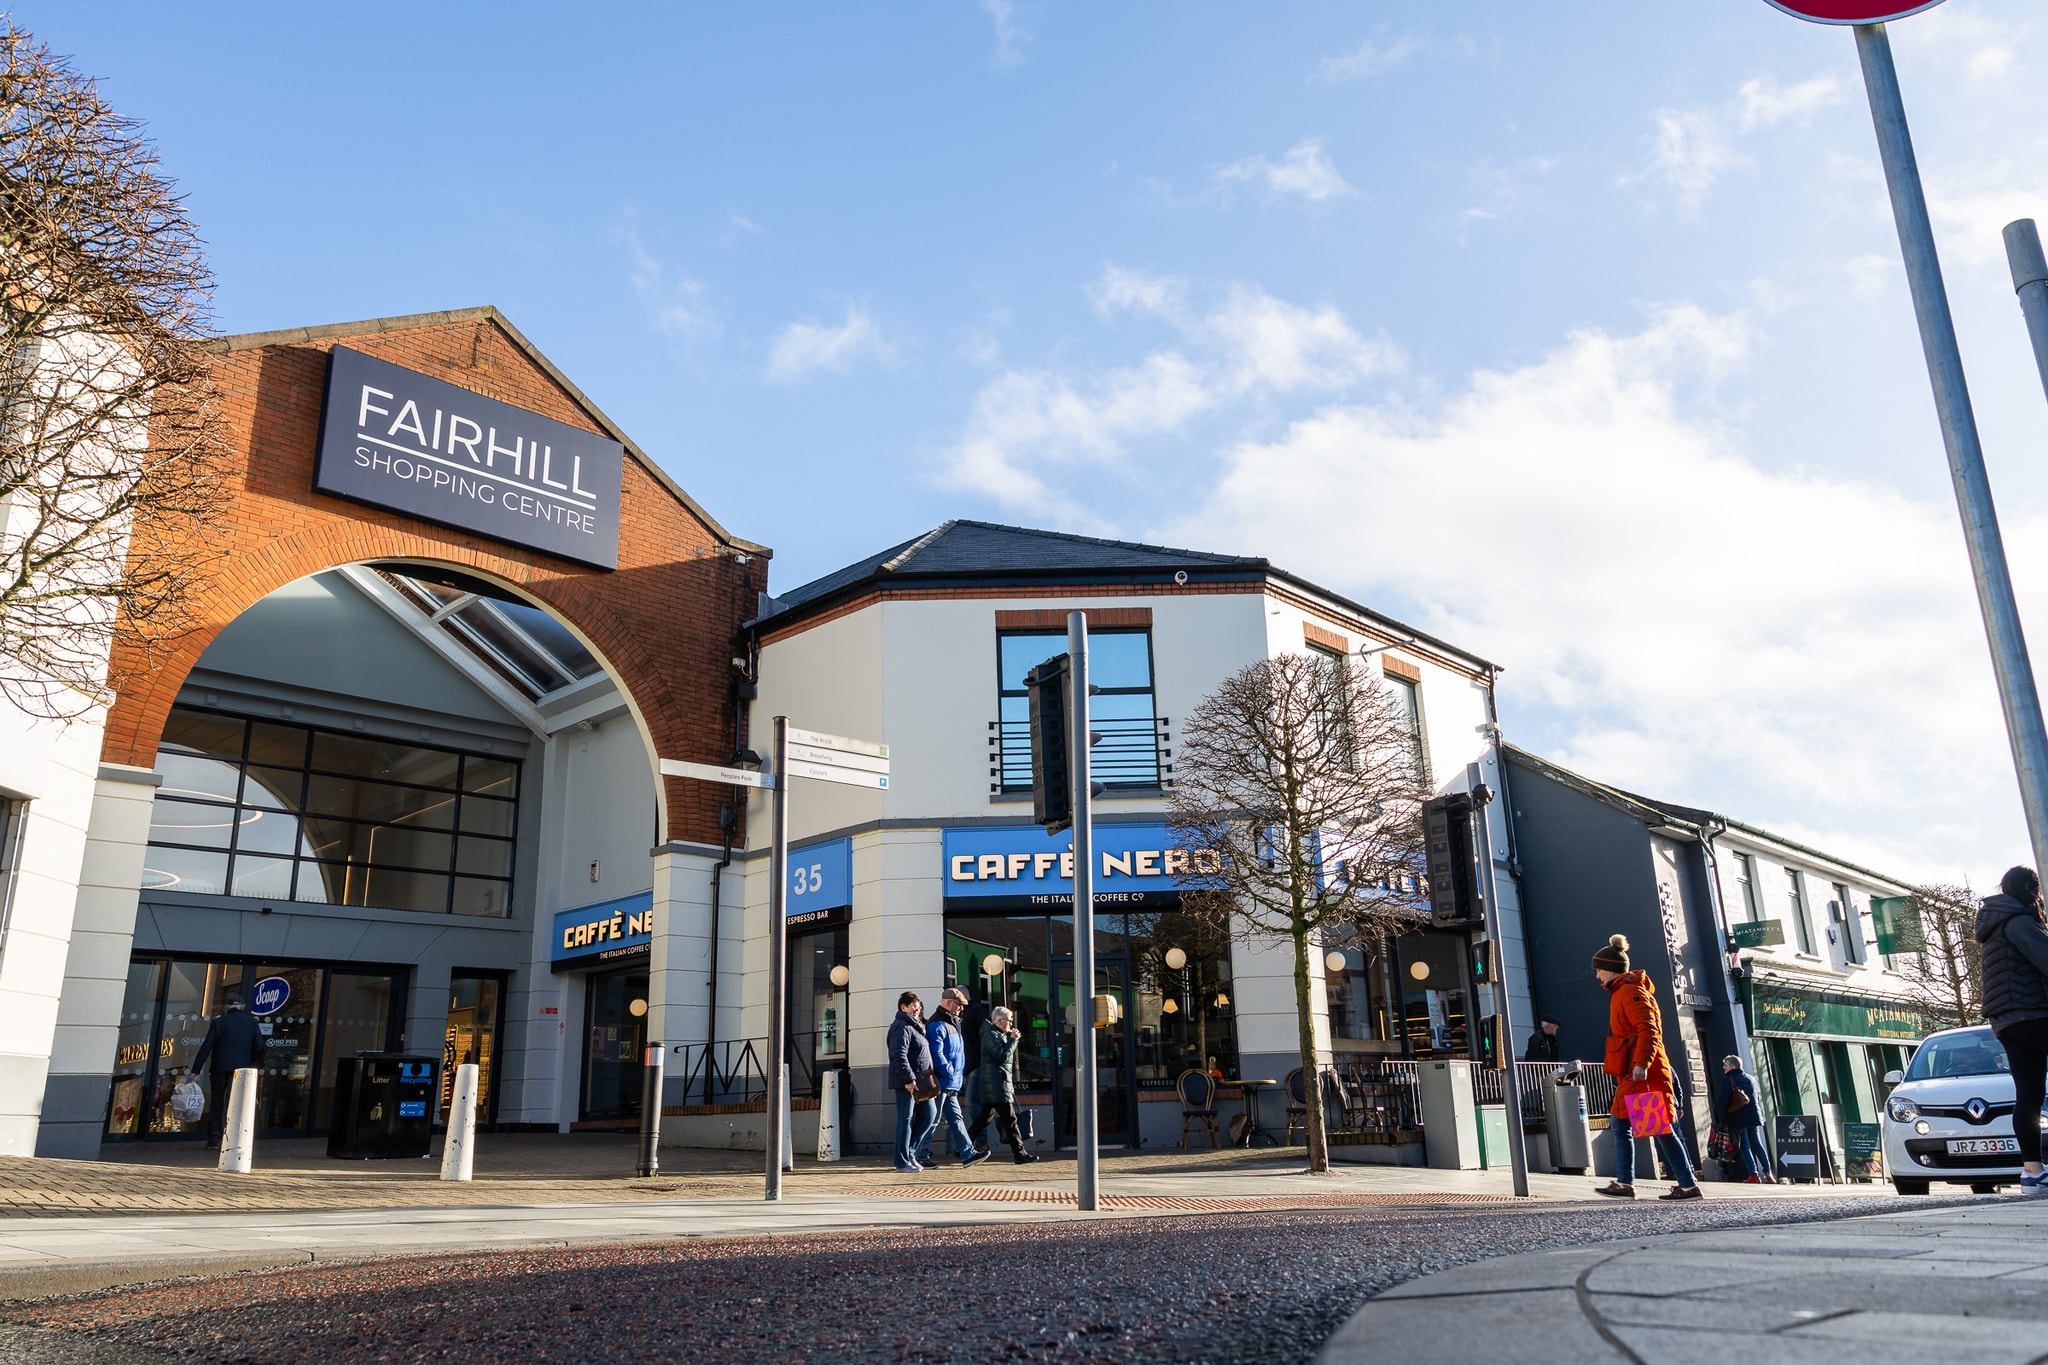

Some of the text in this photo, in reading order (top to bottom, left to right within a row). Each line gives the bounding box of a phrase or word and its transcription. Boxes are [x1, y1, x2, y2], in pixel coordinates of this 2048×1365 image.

[358, 384, 597, 500] FAIRHILL
[353, 446, 596, 535] SHOPPING CENTRE
[810, 735, 819, 744] The
[809, 751, 833, 762] Broadway
[720, 771, 753, 782] Peoples Park
[809, 768, 828, 777] Carpark
[1102, 849, 1222, 877] NERO
[793, 863, 823, 896] 35
[1030, 895, 1049, 904] THE
[1051, 894, 1075, 904] ITALI
[1093, 893, 1129, 902] COFFEE
[787, 910, 829, 925] ESPRESSO BAR
[563, 909, 653, 949] CAFFÈ NE
[600, 952, 608, 960] THE
[608, 947, 626, 958] ITALIAN
[627, 944, 644, 955] COFFEE
[255, 983, 280, 1009] Scoop
[372, 1076, 432, 1085] Litter Recycling
[1141, 1079, 1176, 1087] ESPRESSO
[1953, 1140, 2015, 1153] JRZ 3336
